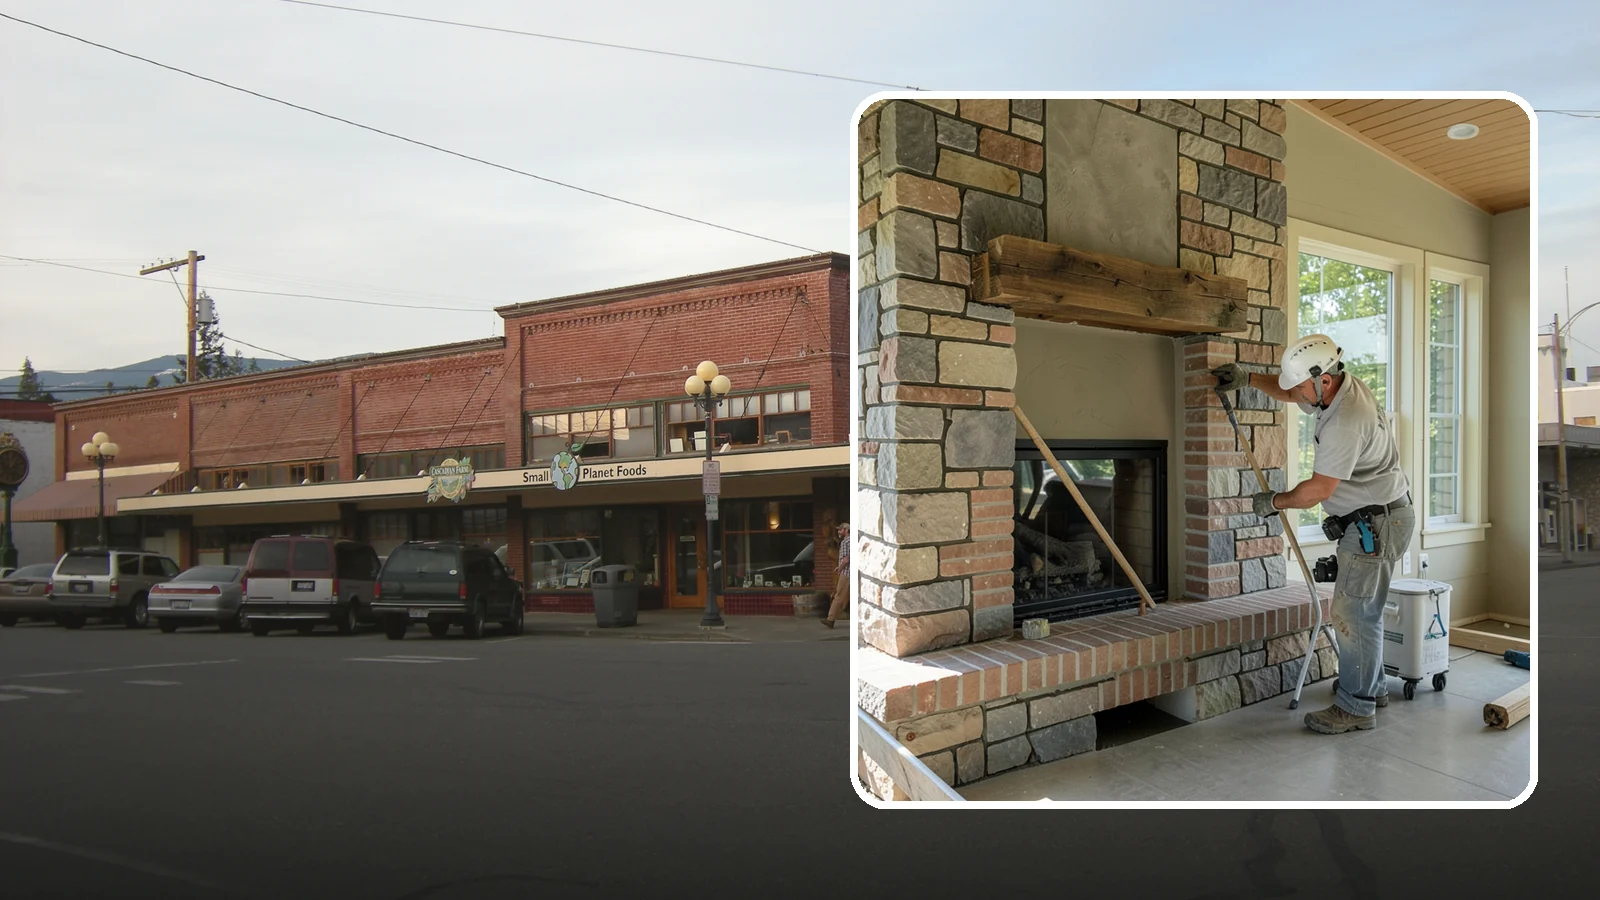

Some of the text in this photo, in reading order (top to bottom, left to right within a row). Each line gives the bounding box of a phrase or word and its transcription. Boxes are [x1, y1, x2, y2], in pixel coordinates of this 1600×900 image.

[523, 464, 647, 483] Small Planet Foods
